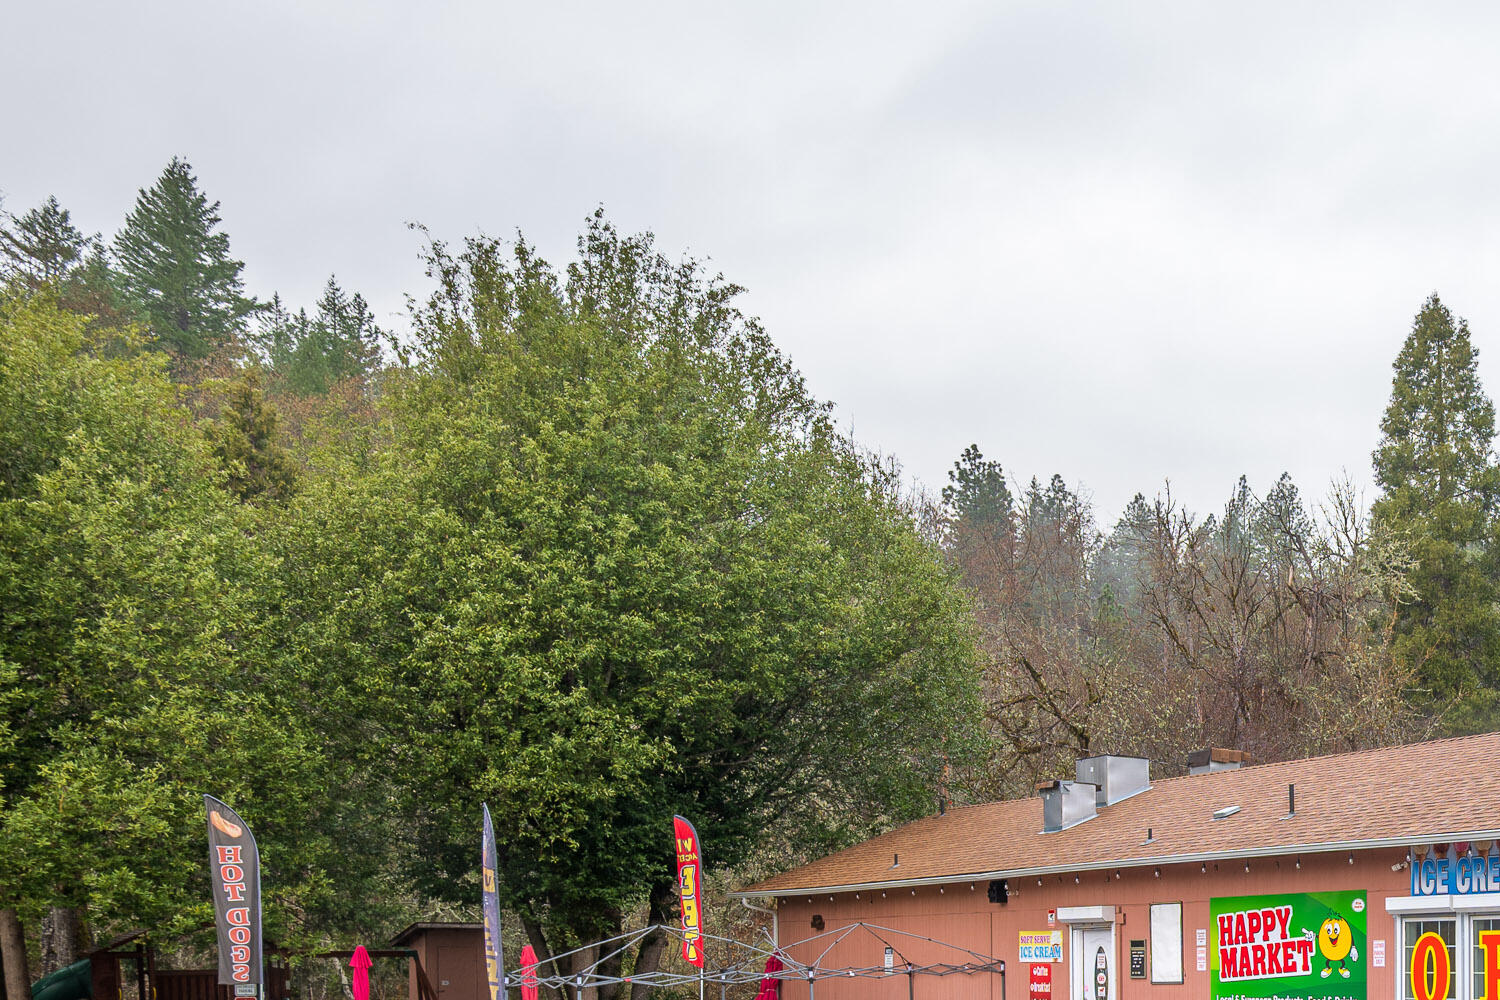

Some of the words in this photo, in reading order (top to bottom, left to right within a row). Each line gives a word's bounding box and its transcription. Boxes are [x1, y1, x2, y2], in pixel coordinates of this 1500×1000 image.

[1413, 858, 1450, 895] ICE
[1218, 907, 1291, 947] HAPPY
[1020, 946, 1033, 958] ICE
[1034, 945, 1061, 958] CREAM
[1220, 940, 1314, 979] MARKET
